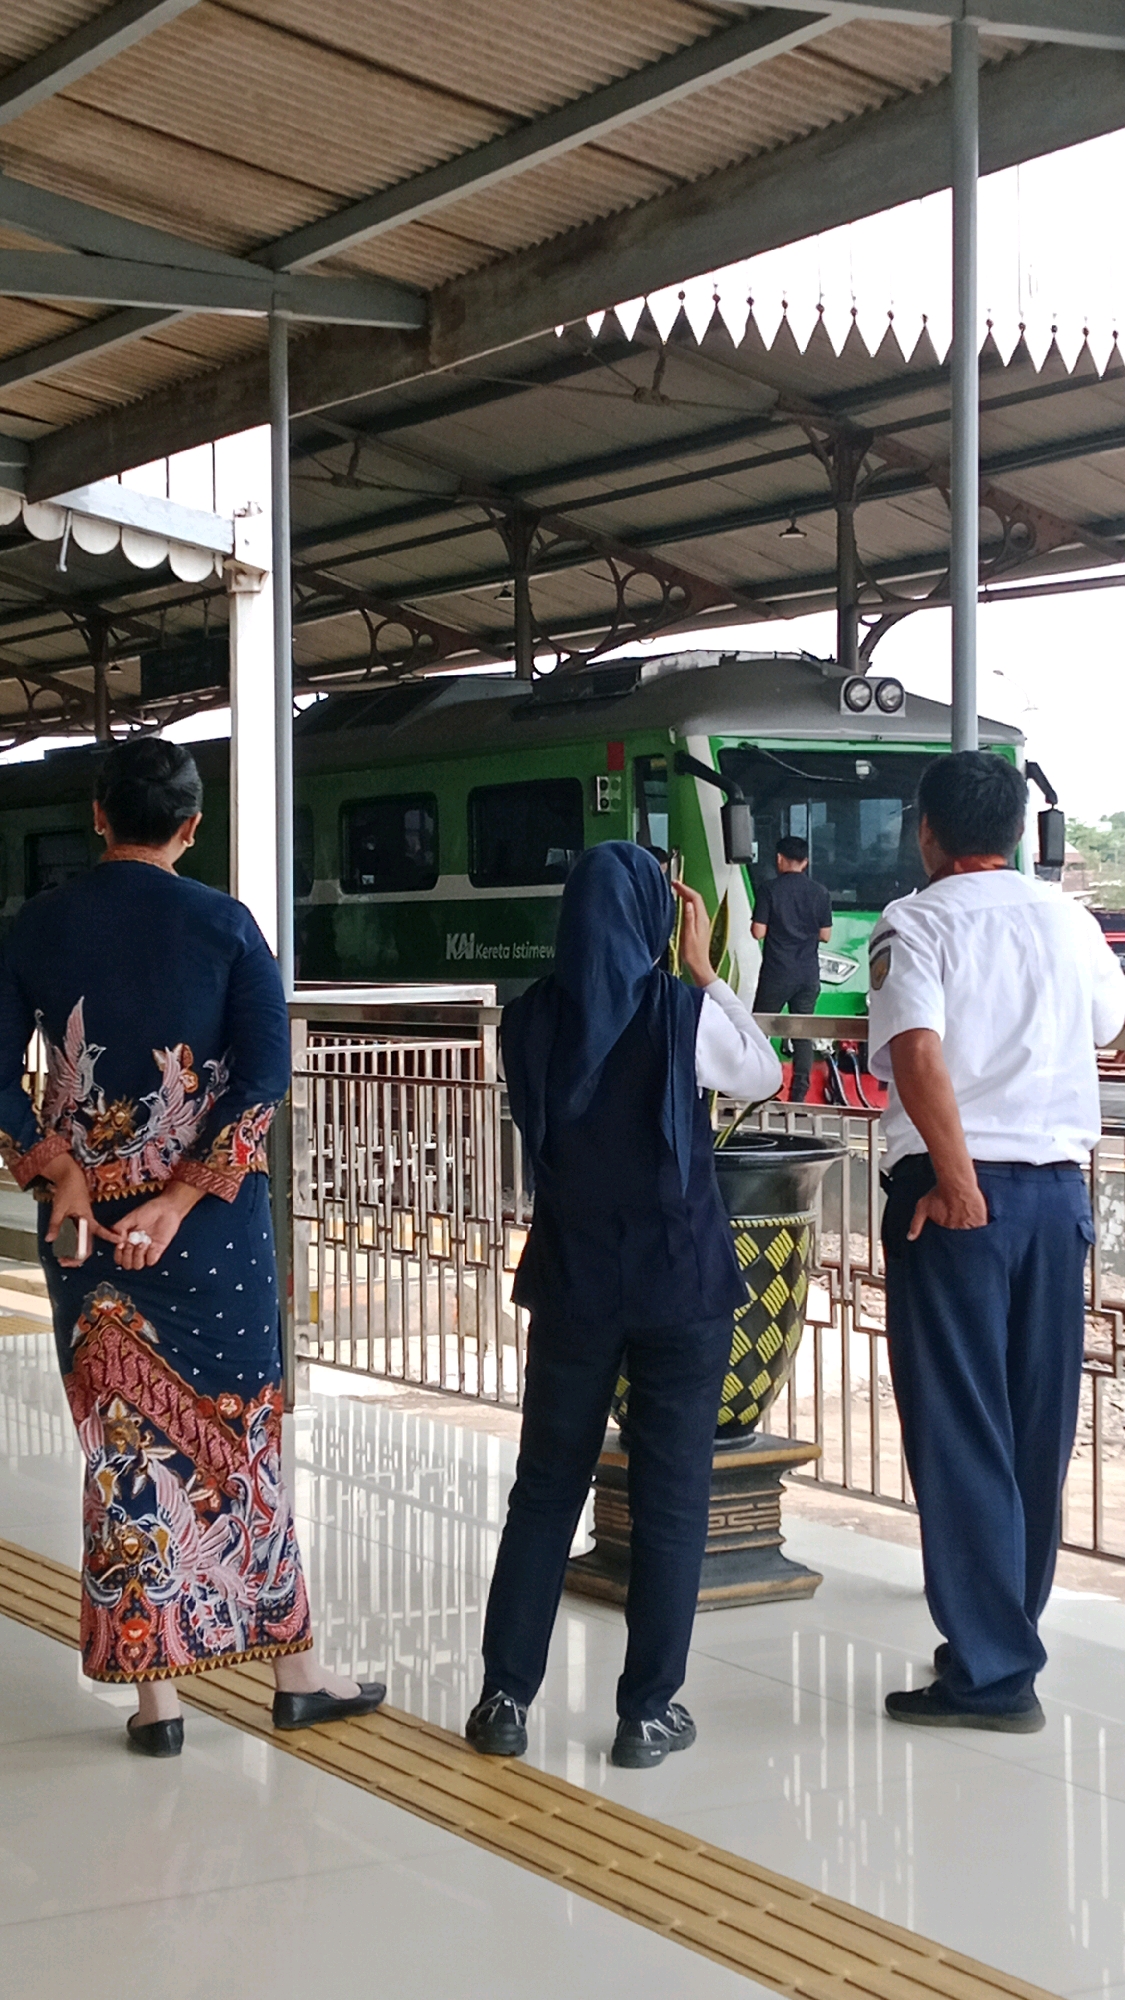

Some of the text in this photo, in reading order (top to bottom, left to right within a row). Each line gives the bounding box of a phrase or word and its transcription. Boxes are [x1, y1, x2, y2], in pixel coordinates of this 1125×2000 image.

[446, 933, 556, 960] KAI Kereta Istimew
